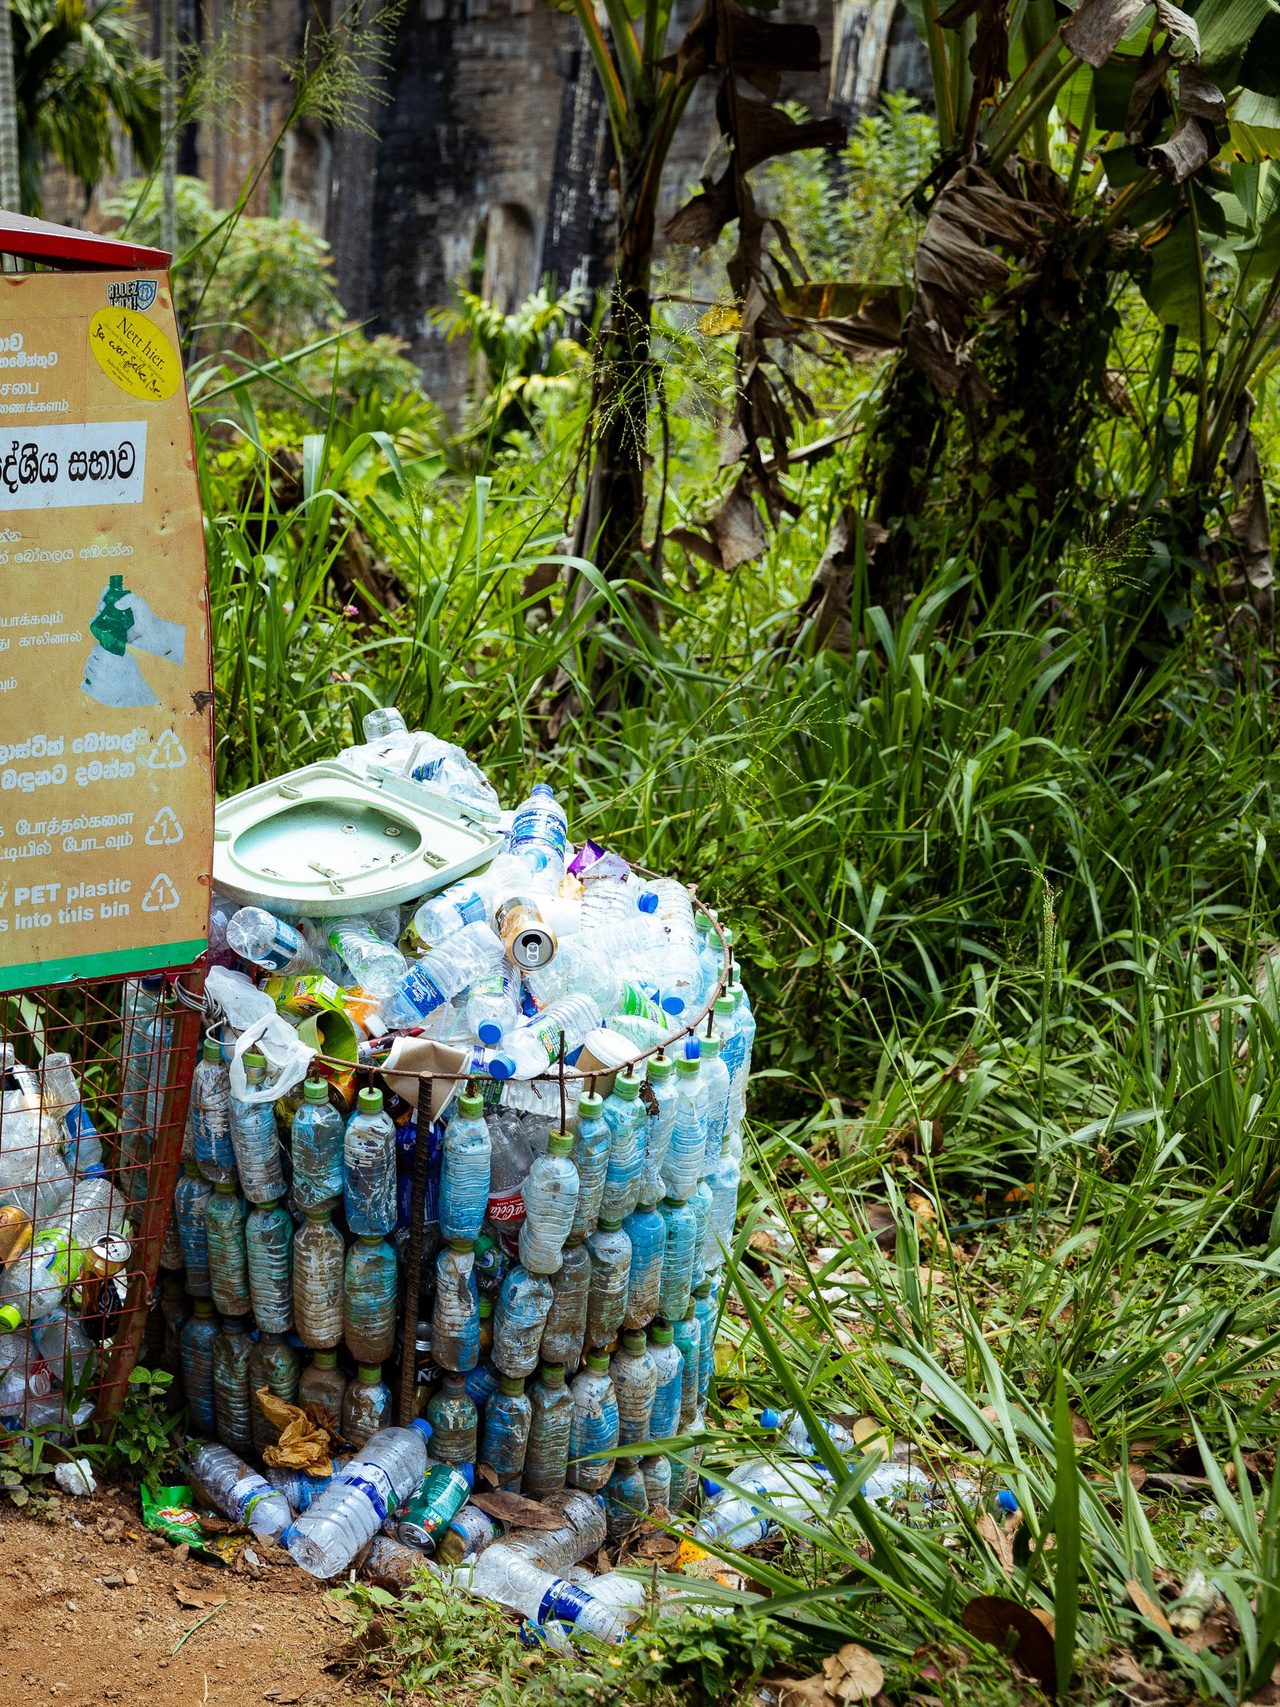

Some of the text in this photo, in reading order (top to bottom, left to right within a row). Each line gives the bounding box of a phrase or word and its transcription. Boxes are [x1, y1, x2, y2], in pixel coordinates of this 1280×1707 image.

[108, 280, 140, 299] ALLEZ
[116, 316, 166, 370] Nett hier.
[68, 441, 136, 483] සභාව
[14, 547, 74, 563] බෝතලය
[19, 630, 83, 647] காலினால்
[75, 760, 136, 787] දමන්න
[15, 811, 135, 837] போத்தல்களை
[62, 831, 134, 855] போடவும்
[14, 884, 62, 906] PET
[67, 878, 132, 904] plastic
[15, 910, 52, 930] into
[58, 906, 95, 924] this
[101, 901, 130, 918] bin
